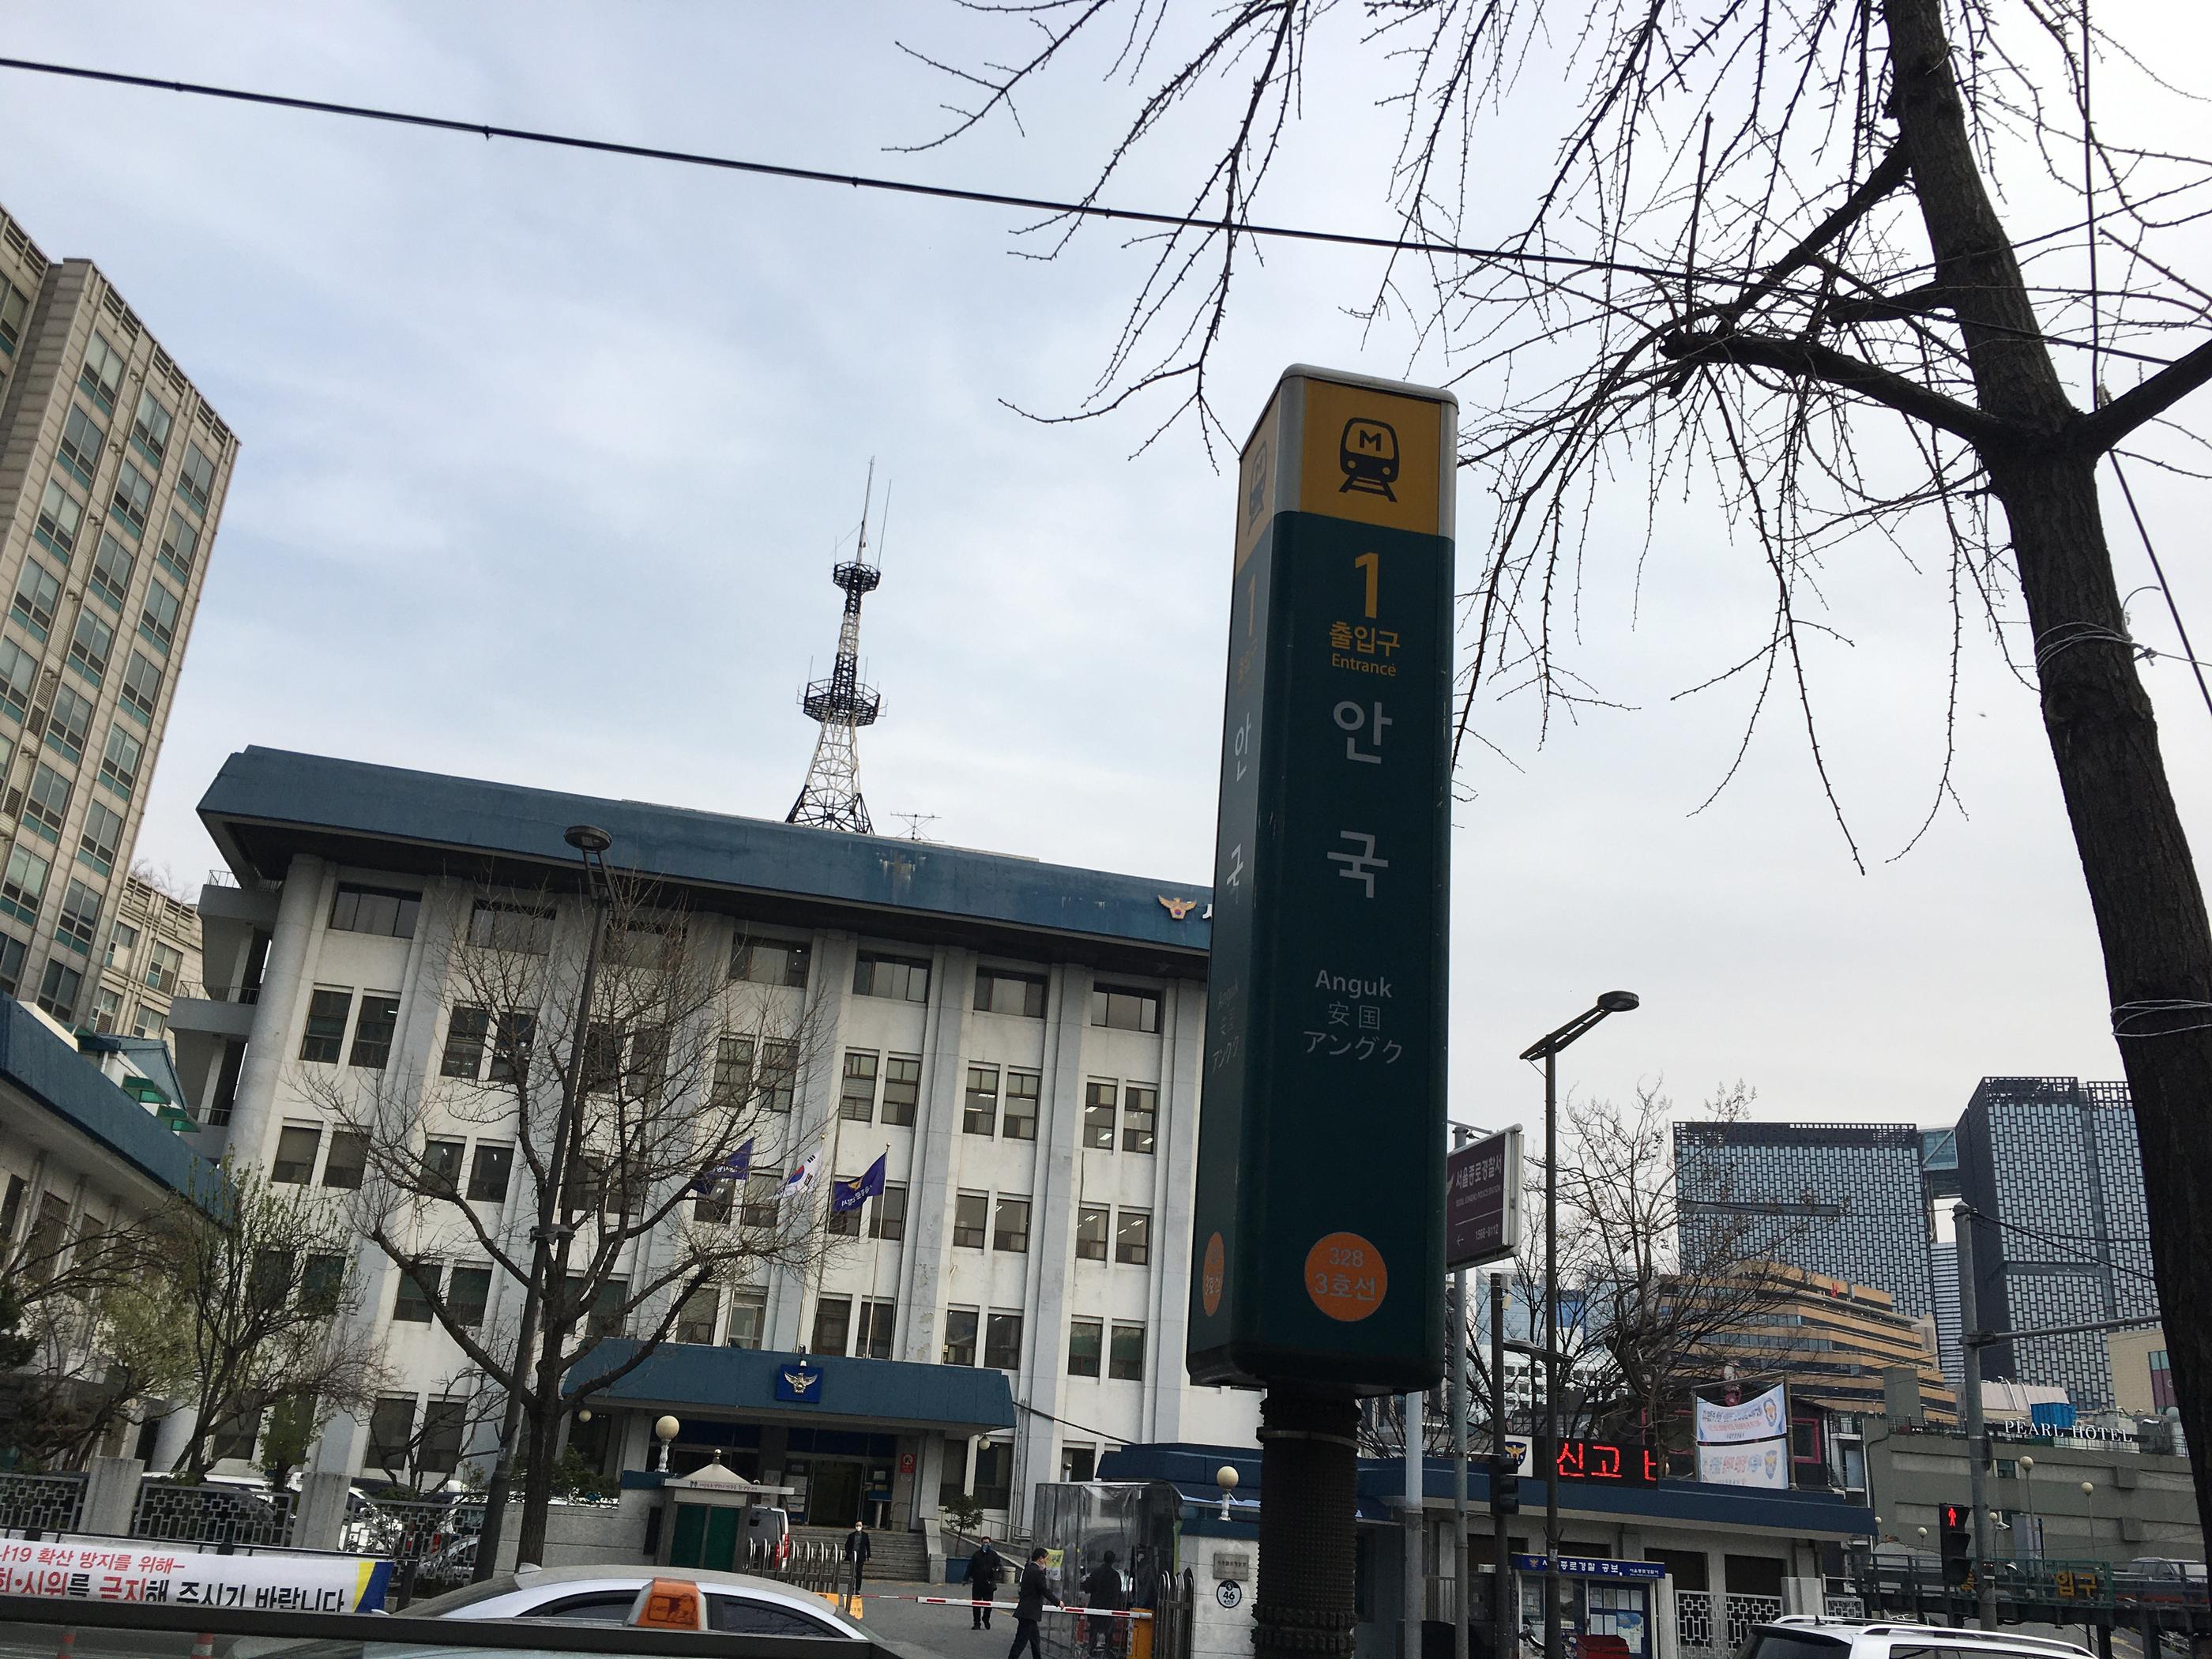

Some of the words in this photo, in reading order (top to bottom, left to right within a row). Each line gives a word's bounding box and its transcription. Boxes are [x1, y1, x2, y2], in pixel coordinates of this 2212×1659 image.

[1359, 429, 1382, 452] M
[1355, 551, 1379, 619] 1
[1329, 621, 1400, 657] 출입구
[1331, 653, 1397, 677] Entrance
[1315, 969, 1392, 999] Anguk
[1327, 1001, 1381, 1032] 安国
[1303, 1030, 1402, 1065] アングク
[1455, 1154, 1502, 1190] 서울종로경찰서
[1329, 1246, 1364, 1269] 328
[1314, 1272, 1376, 1303] 3호선
[2003, 1419, 2064, 1438] PEARL
[2071, 1425, 2133, 1443] HOTEL
[1556, 1442, 1623, 1479] 신고
[37, 1548, 73, 1567] 확산
[79, 1552, 132, 1572] 방지를
[100, 1576, 170, 1603] 금지해
[176, 1582, 246, 1608] 주시기
[255, 1586, 344, 1613] 바랍니다
[1222, 1590, 1236, 1601] 46
[2056, 1570, 2098, 1598] 입구
